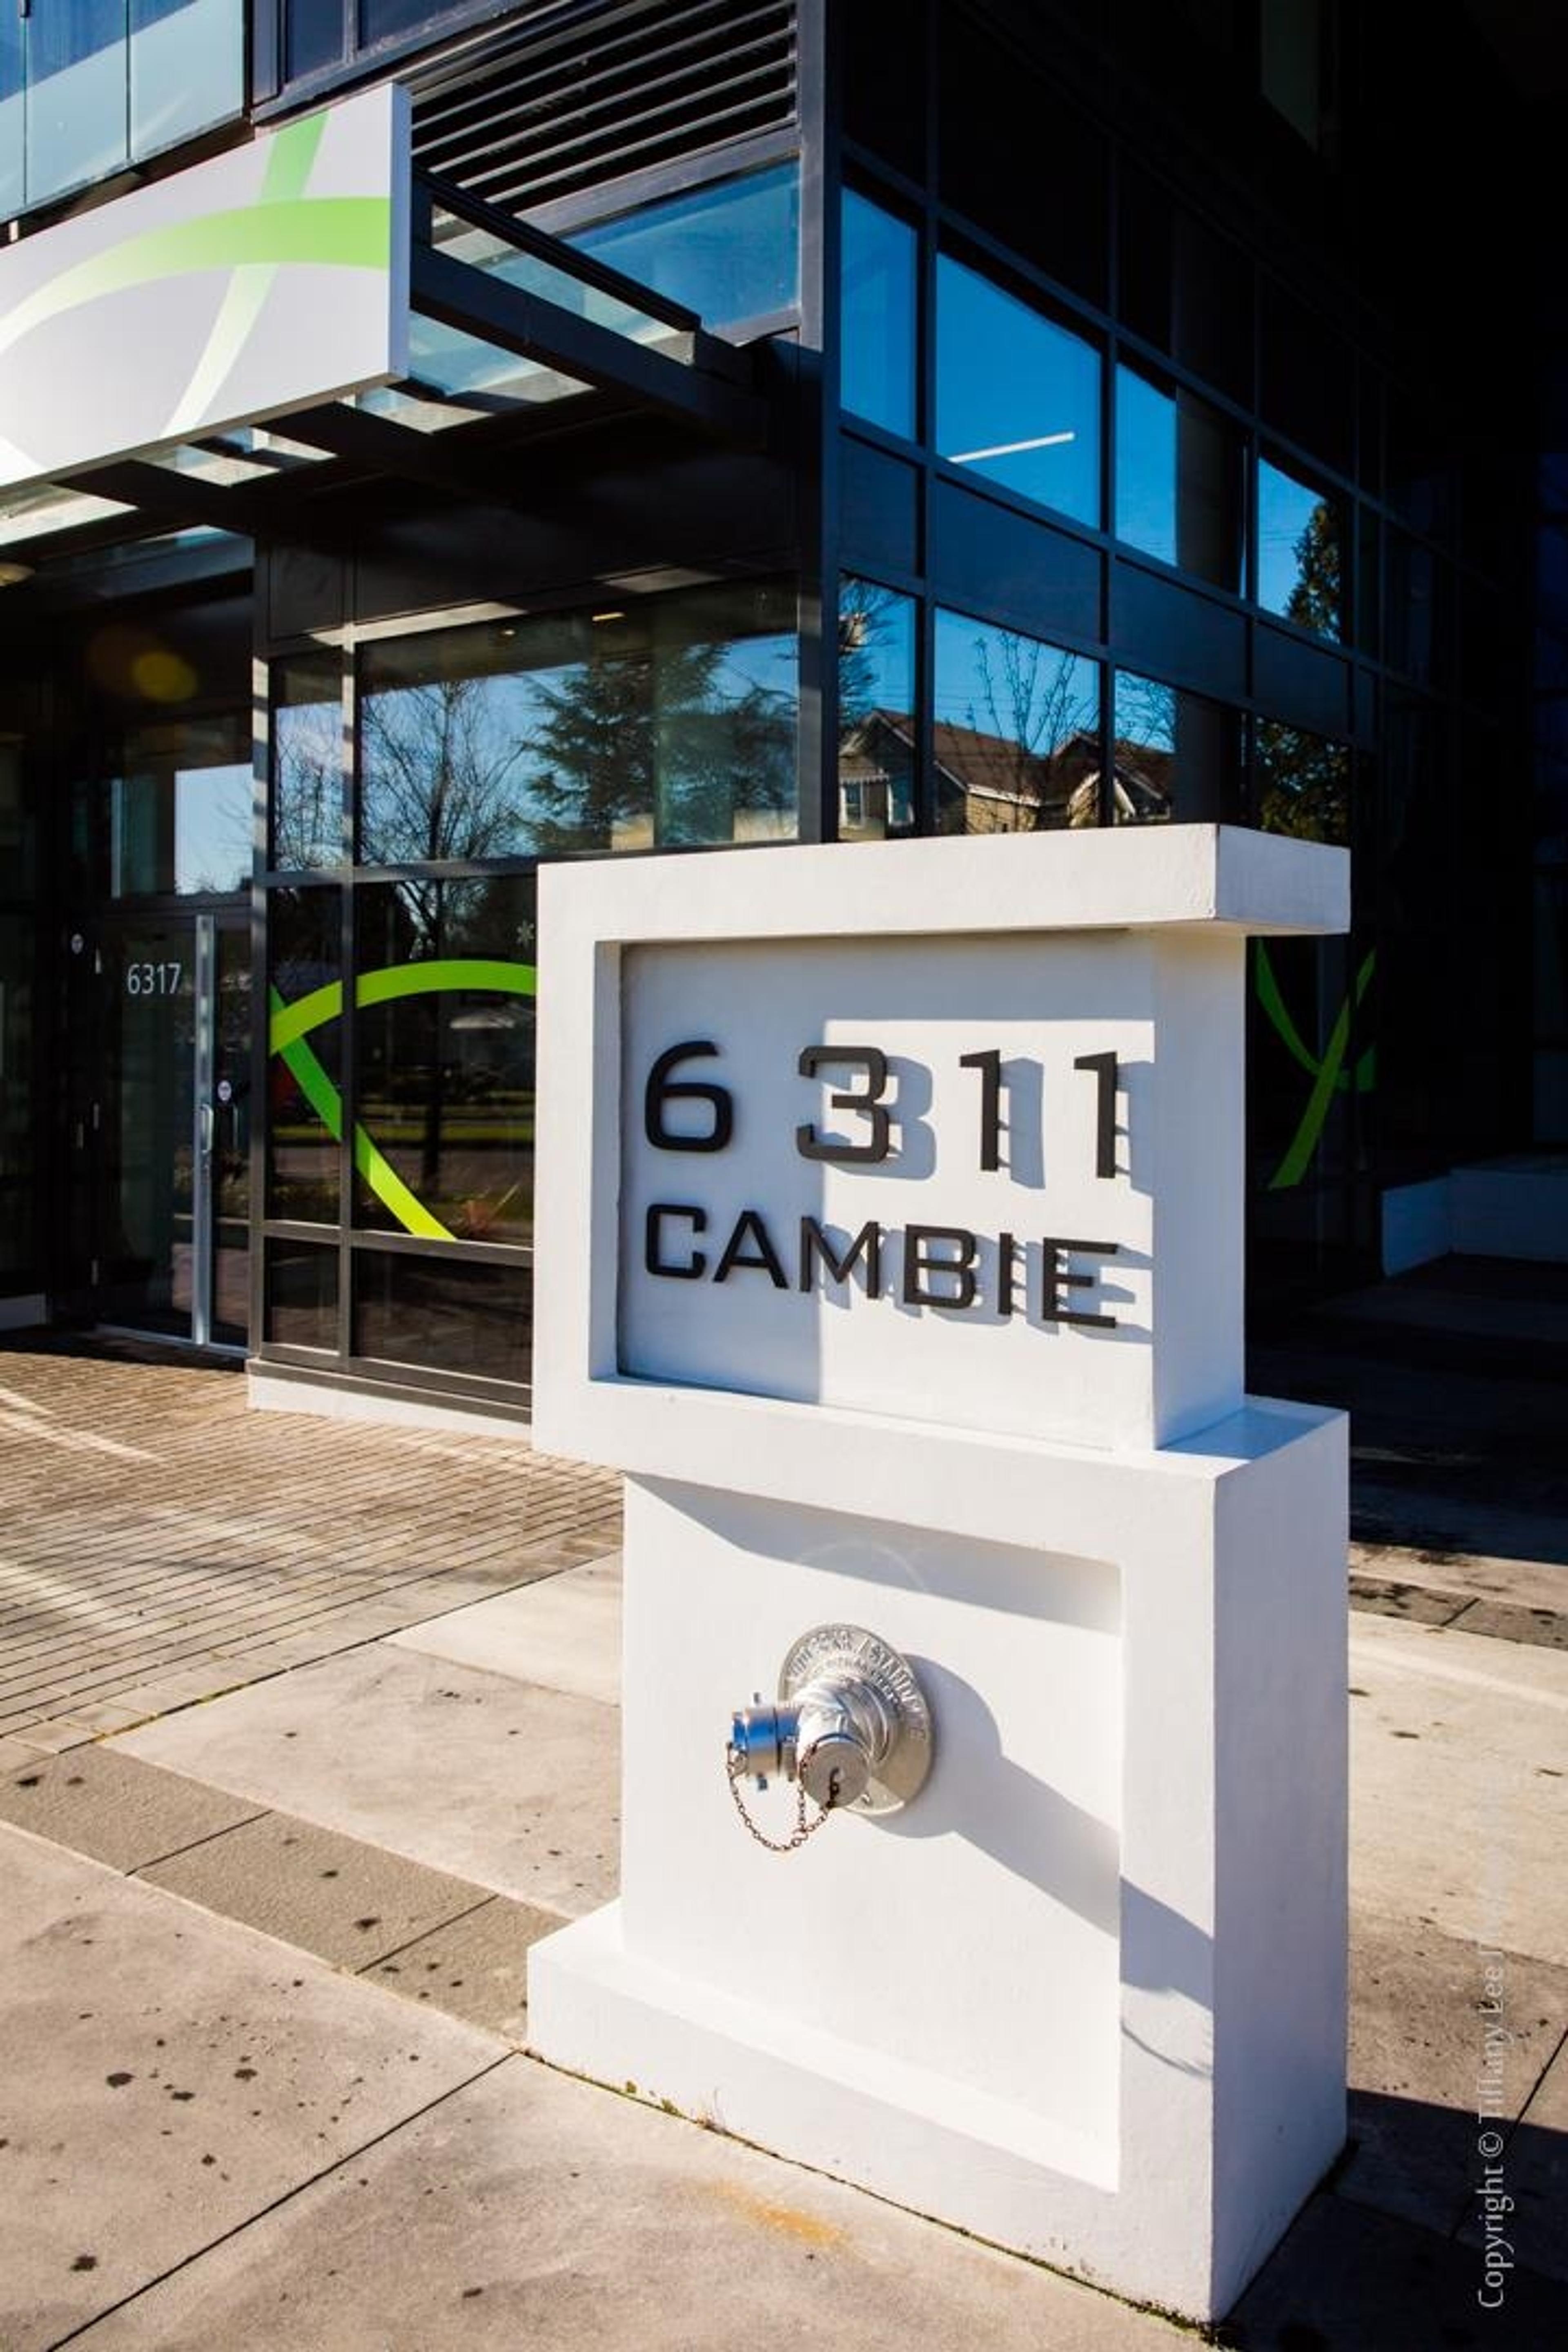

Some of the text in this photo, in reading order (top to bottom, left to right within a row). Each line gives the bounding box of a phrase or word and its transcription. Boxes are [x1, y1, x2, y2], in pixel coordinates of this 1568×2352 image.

[128, 963, 181, 994] 6317
[644, 1040, 1117, 1179] 6311
[644, 1203, 1119, 1329] CAMBIE
